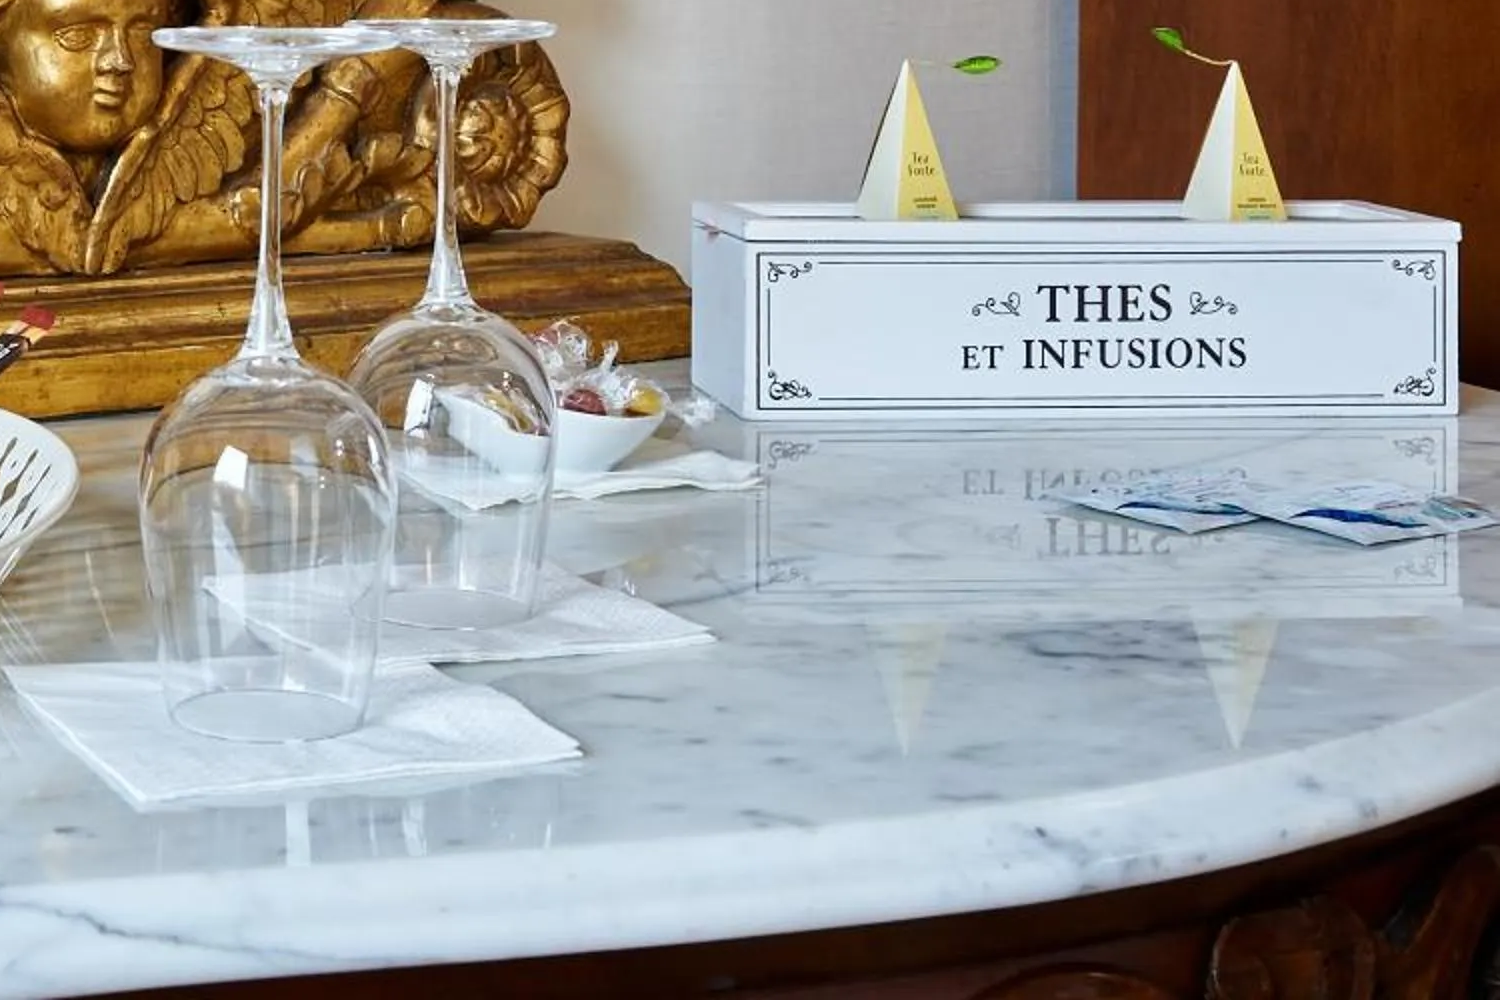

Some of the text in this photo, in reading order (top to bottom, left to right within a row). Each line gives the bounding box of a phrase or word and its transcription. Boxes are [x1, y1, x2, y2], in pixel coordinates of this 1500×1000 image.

[1036, 283, 1173, 322] THES
[961, 337, 1247, 370] ET INFUSIONS
